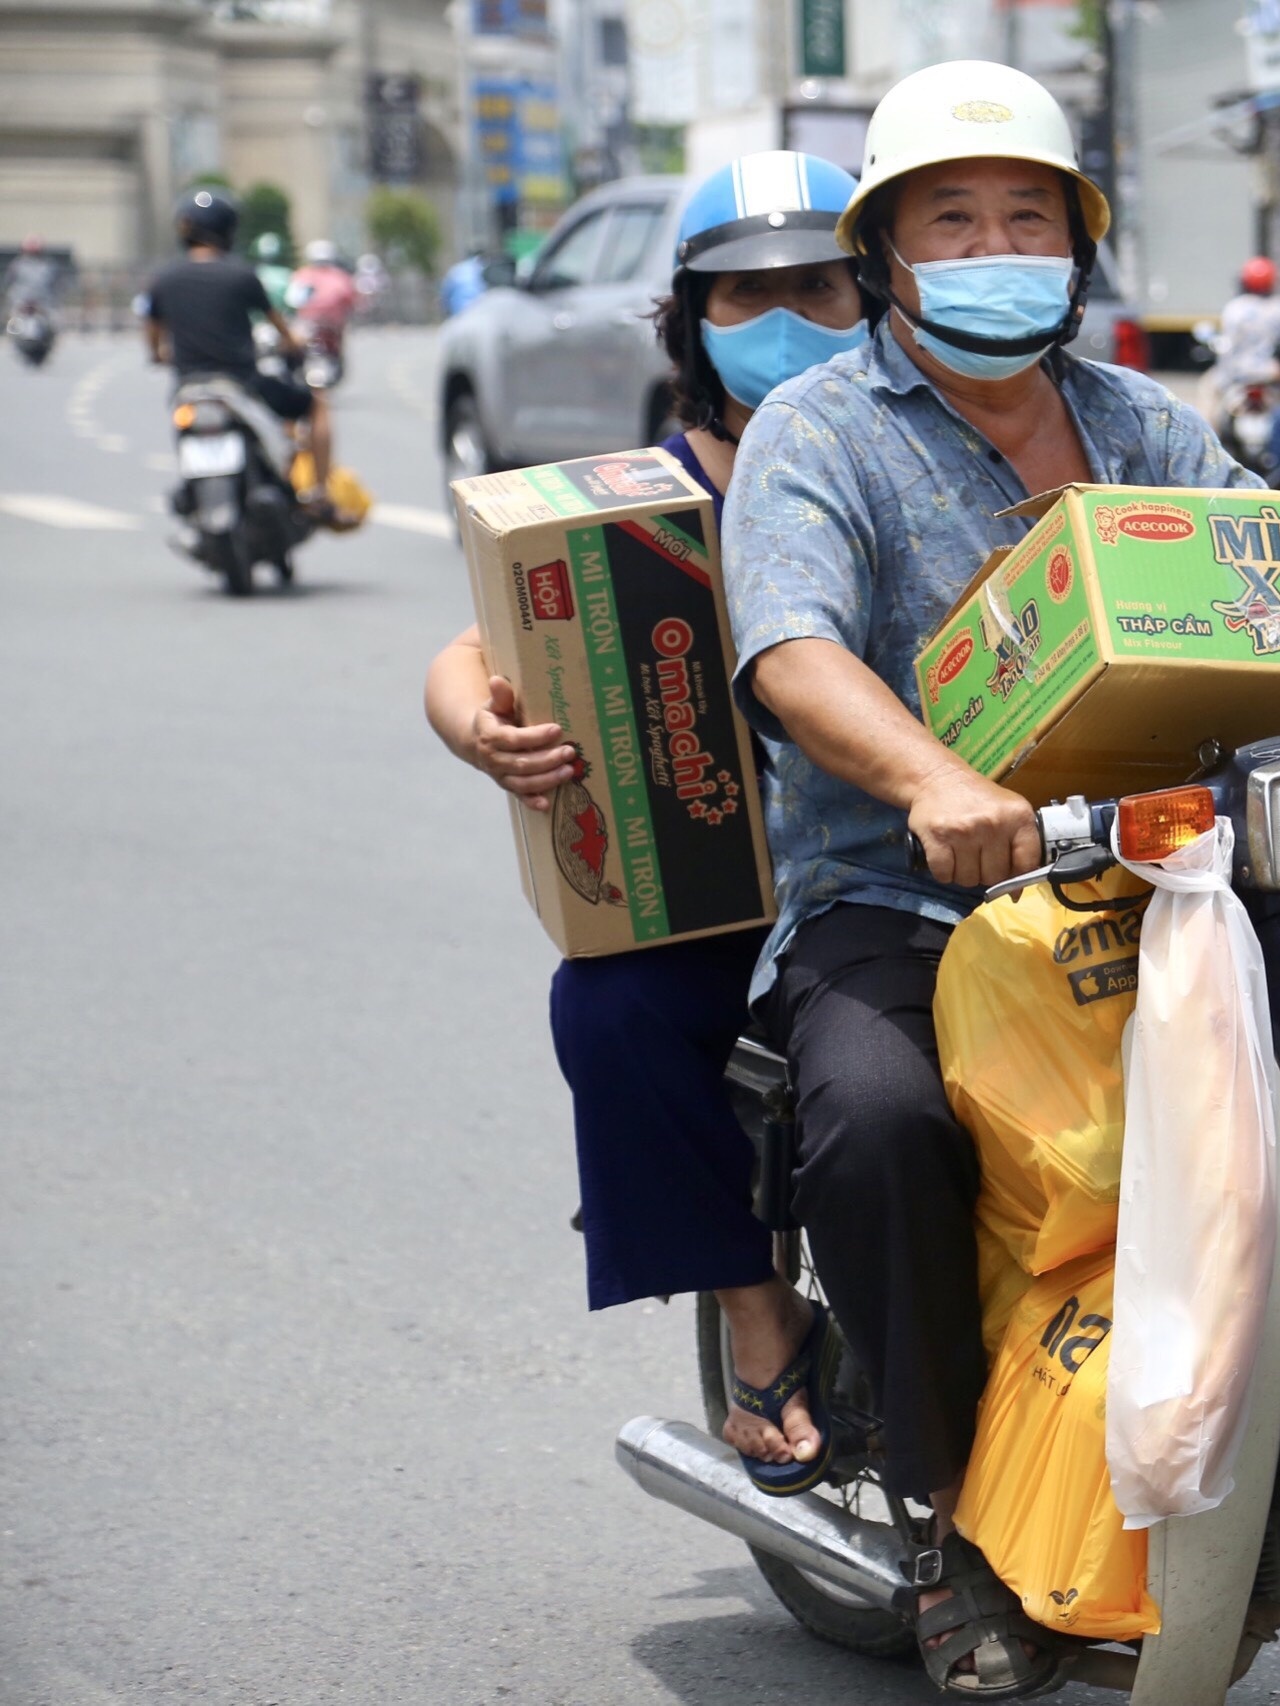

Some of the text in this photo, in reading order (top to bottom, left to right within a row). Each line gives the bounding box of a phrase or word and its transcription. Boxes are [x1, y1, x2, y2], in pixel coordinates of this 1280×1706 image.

[1115, 502, 1191, 519] Cook happiness
[533, 571, 560, 617] HỘP
[1117, 613, 1213, 637] THẬP CẨM
[651, 617, 718, 800] Omachi
[579, 551, 664, 919] MÌ TRỘN MÌ TRỘN MÌ TRỘN
[1107, 974, 1137, 991] App
